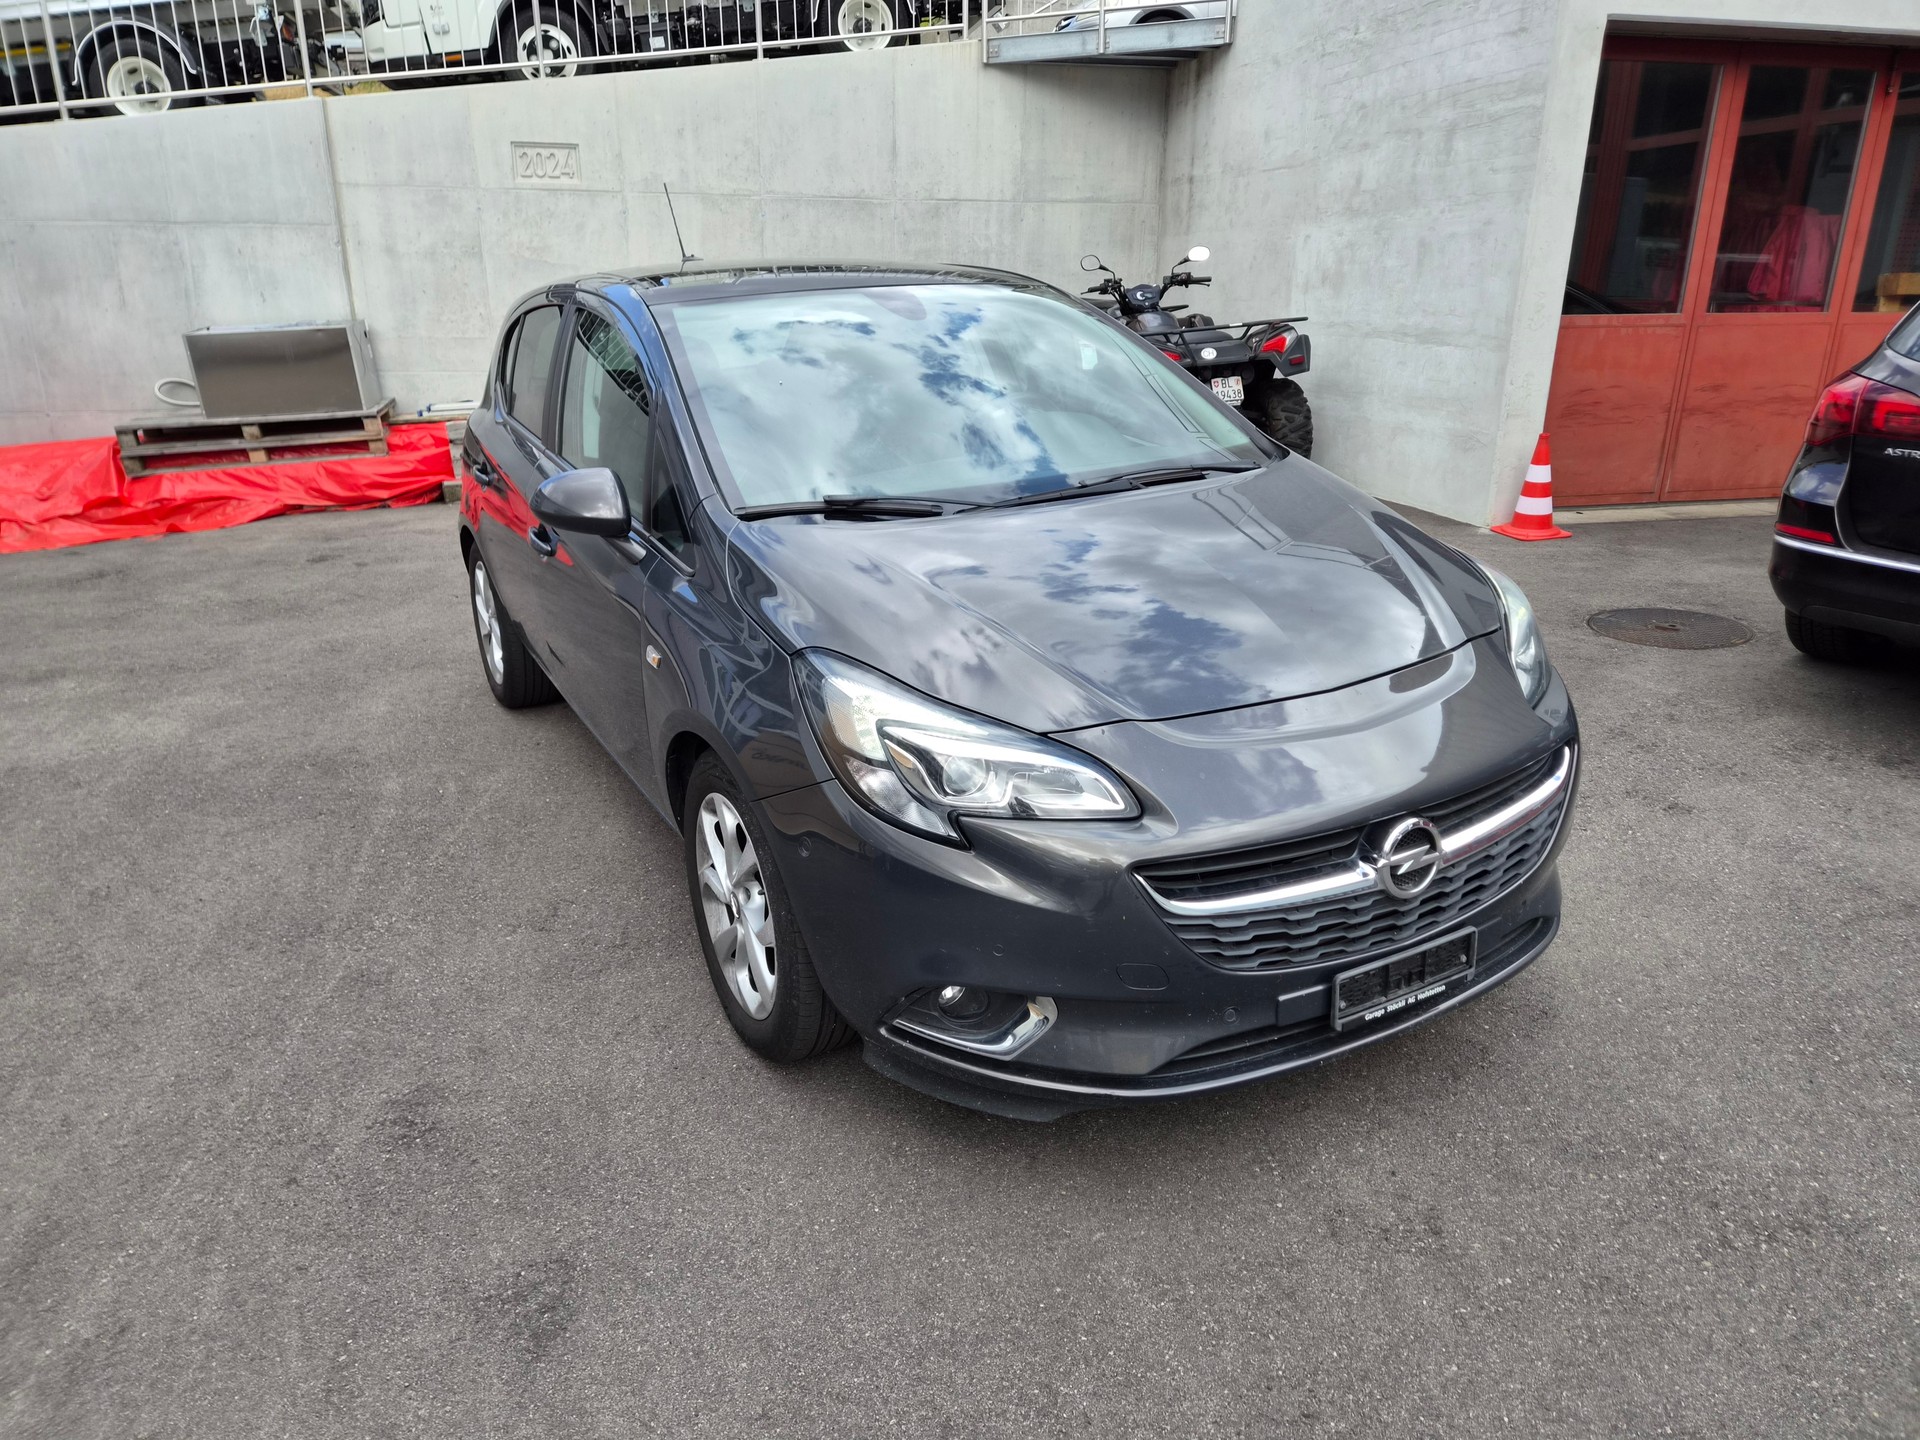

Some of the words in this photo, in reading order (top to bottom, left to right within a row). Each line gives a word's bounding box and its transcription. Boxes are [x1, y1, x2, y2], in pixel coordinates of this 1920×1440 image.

[519, 149, 575, 179] 2024
[1202, 350, 1215, 358] CH
[1221, 379, 1233, 388] BL
[1364, 1008, 1385, 1021] Garage
[1407, 996, 1416, 1005] AG
